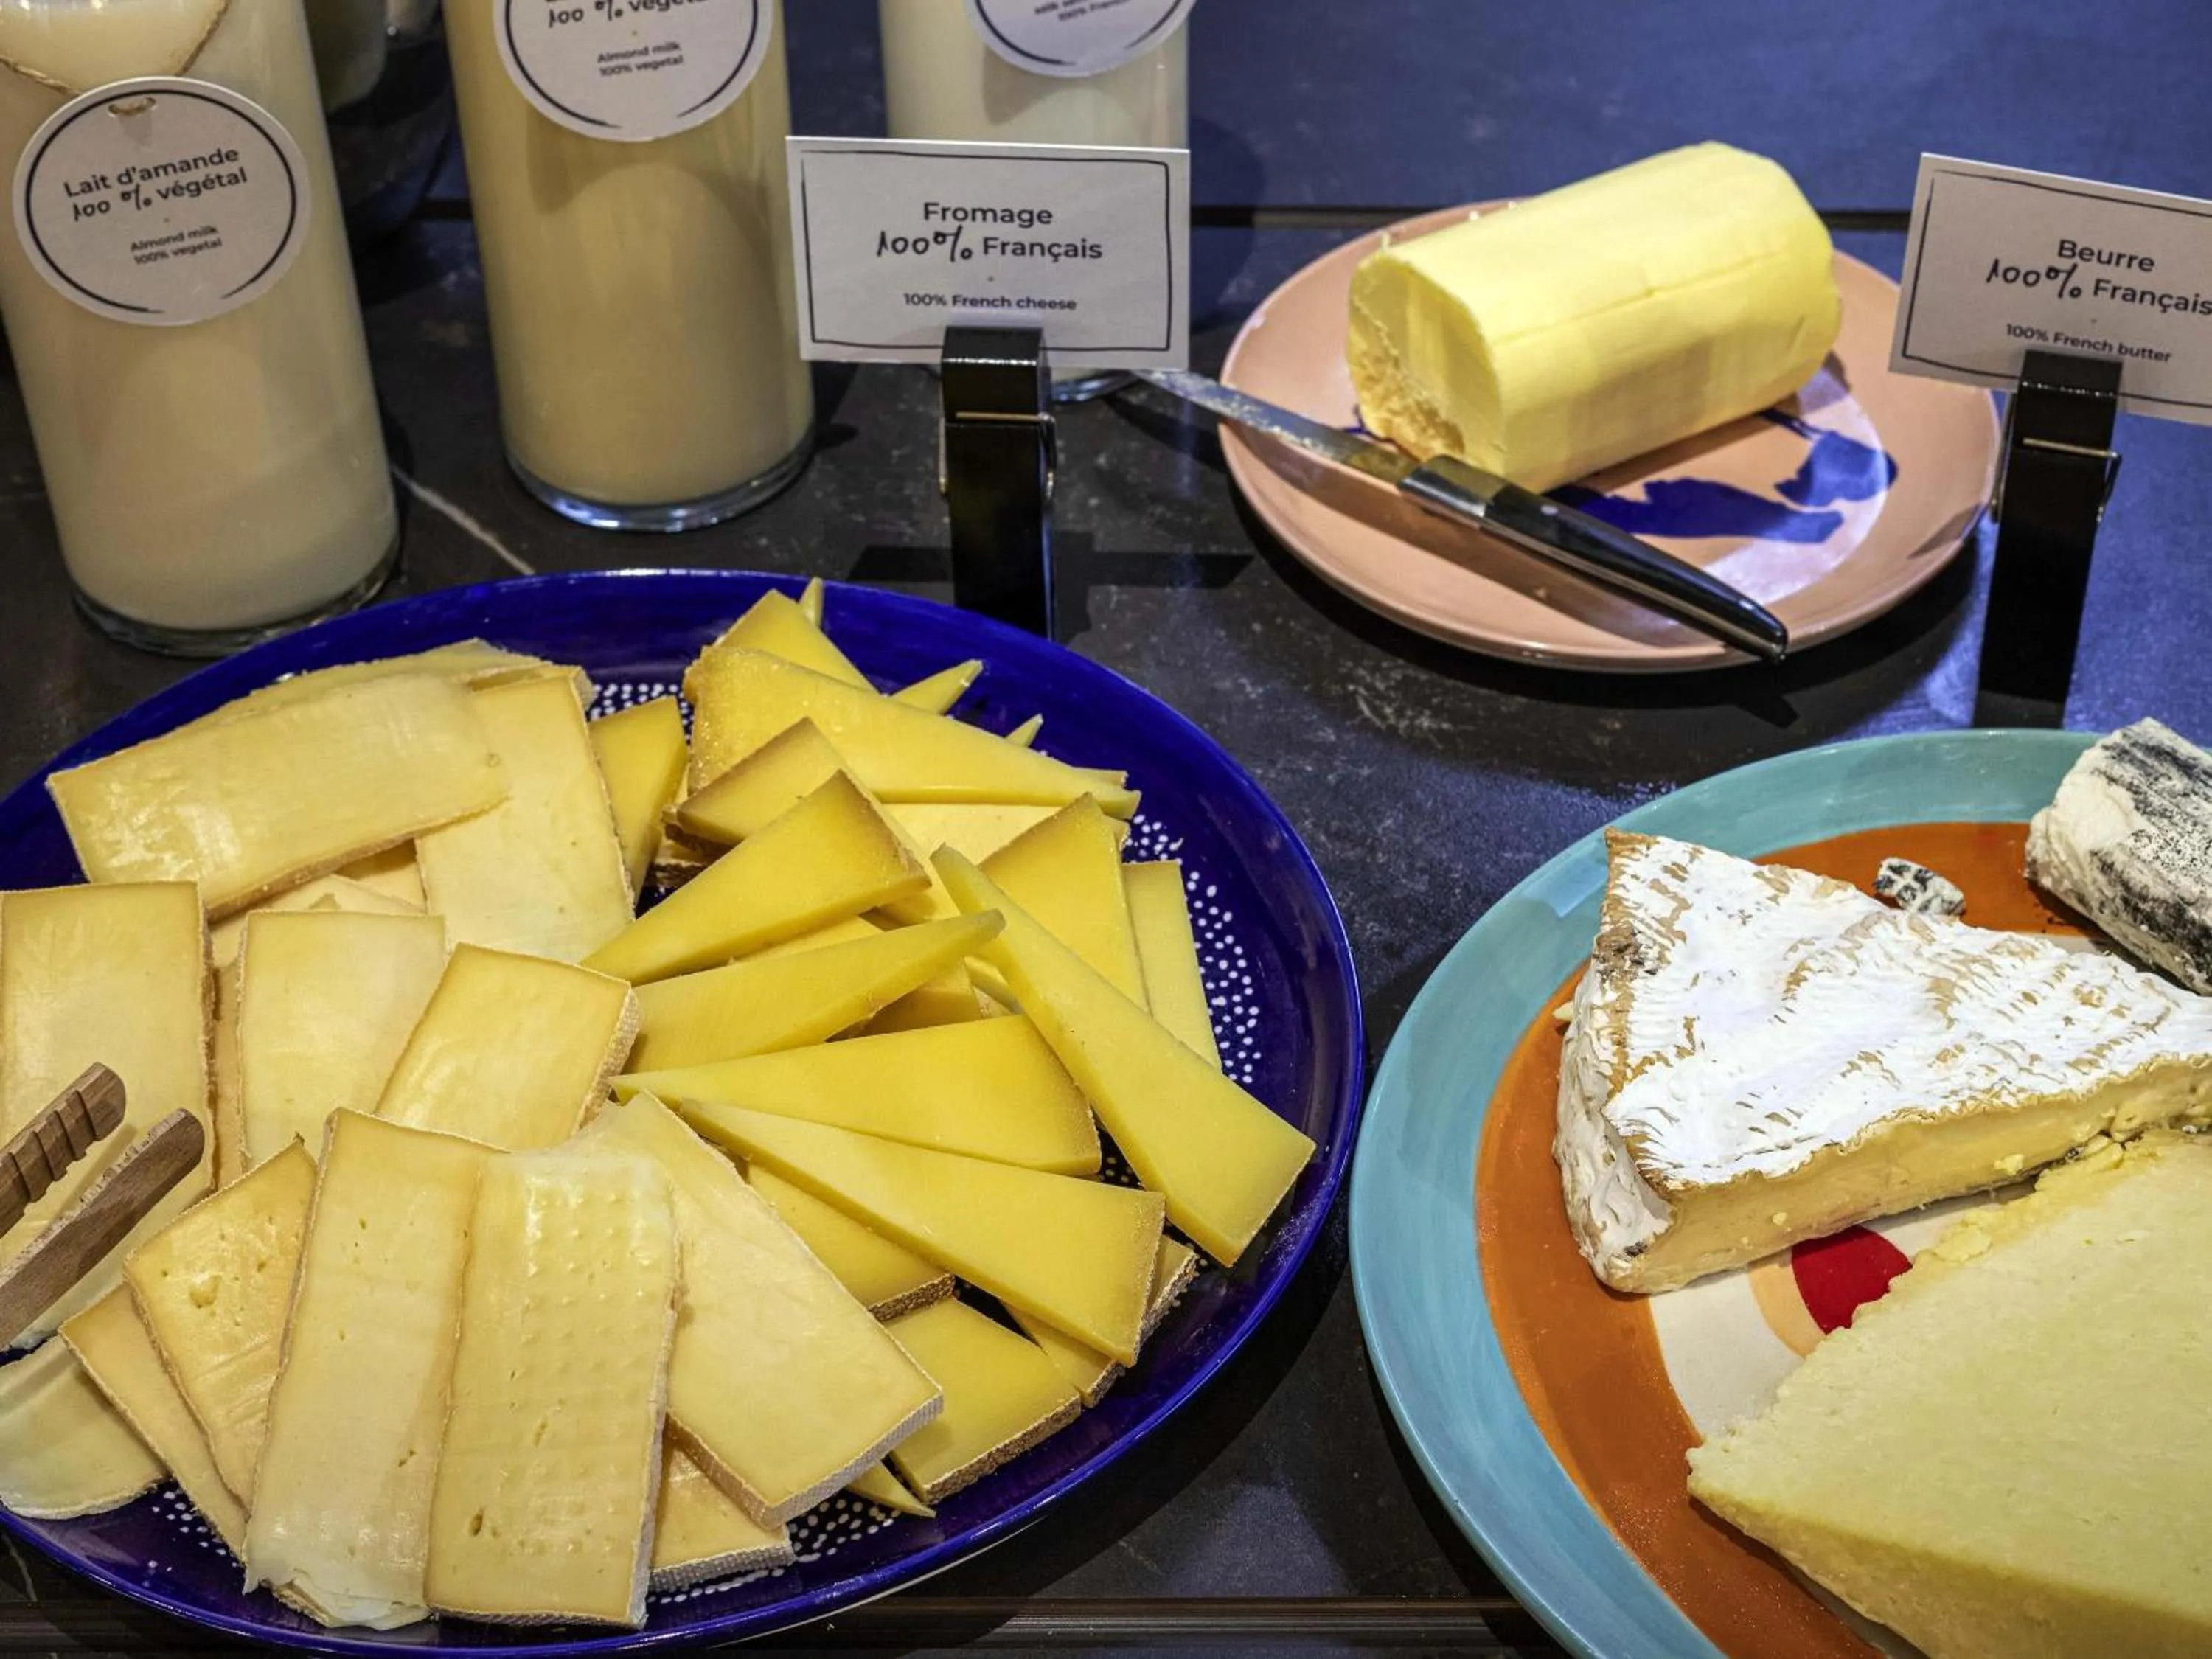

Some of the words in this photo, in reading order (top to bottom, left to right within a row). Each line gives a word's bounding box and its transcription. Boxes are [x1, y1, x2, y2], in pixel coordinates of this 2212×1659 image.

[549, 8, 585, 28] 100
[598, 46, 650, 63] Almond
[653, 42, 681, 54] milk
[636, 55, 684, 71] vegetal
[64, 175, 111, 198] Lait
[116, 148, 239, 184] d'amande
[73, 201, 111, 223] 100
[156, 168, 248, 199] végétal
[924, 202, 1054, 229] Fromage
[131, 232, 186, 252] Almond
[188, 226, 218, 238] milk
[134, 251, 170, 265] 100%
[172, 238, 223, 257] vegetal
[877, 224, 973, 262] 100%
[984, 237, 1103, 262] Français
[2058, 240, 2155, 273] Beurre
[1986, 259, 2083, 299] 100%
[2093, 279, 2212, 316] Français
[903, 293, 947, 307] 100%
[952, 294, 1012, 309] French
[1015, 296, 1077, 311] cheese
[2007, 324, 2049, 342] 100%
[2053, 332, 2112, 352] French
[2117, 343, 2171, 362] butter
